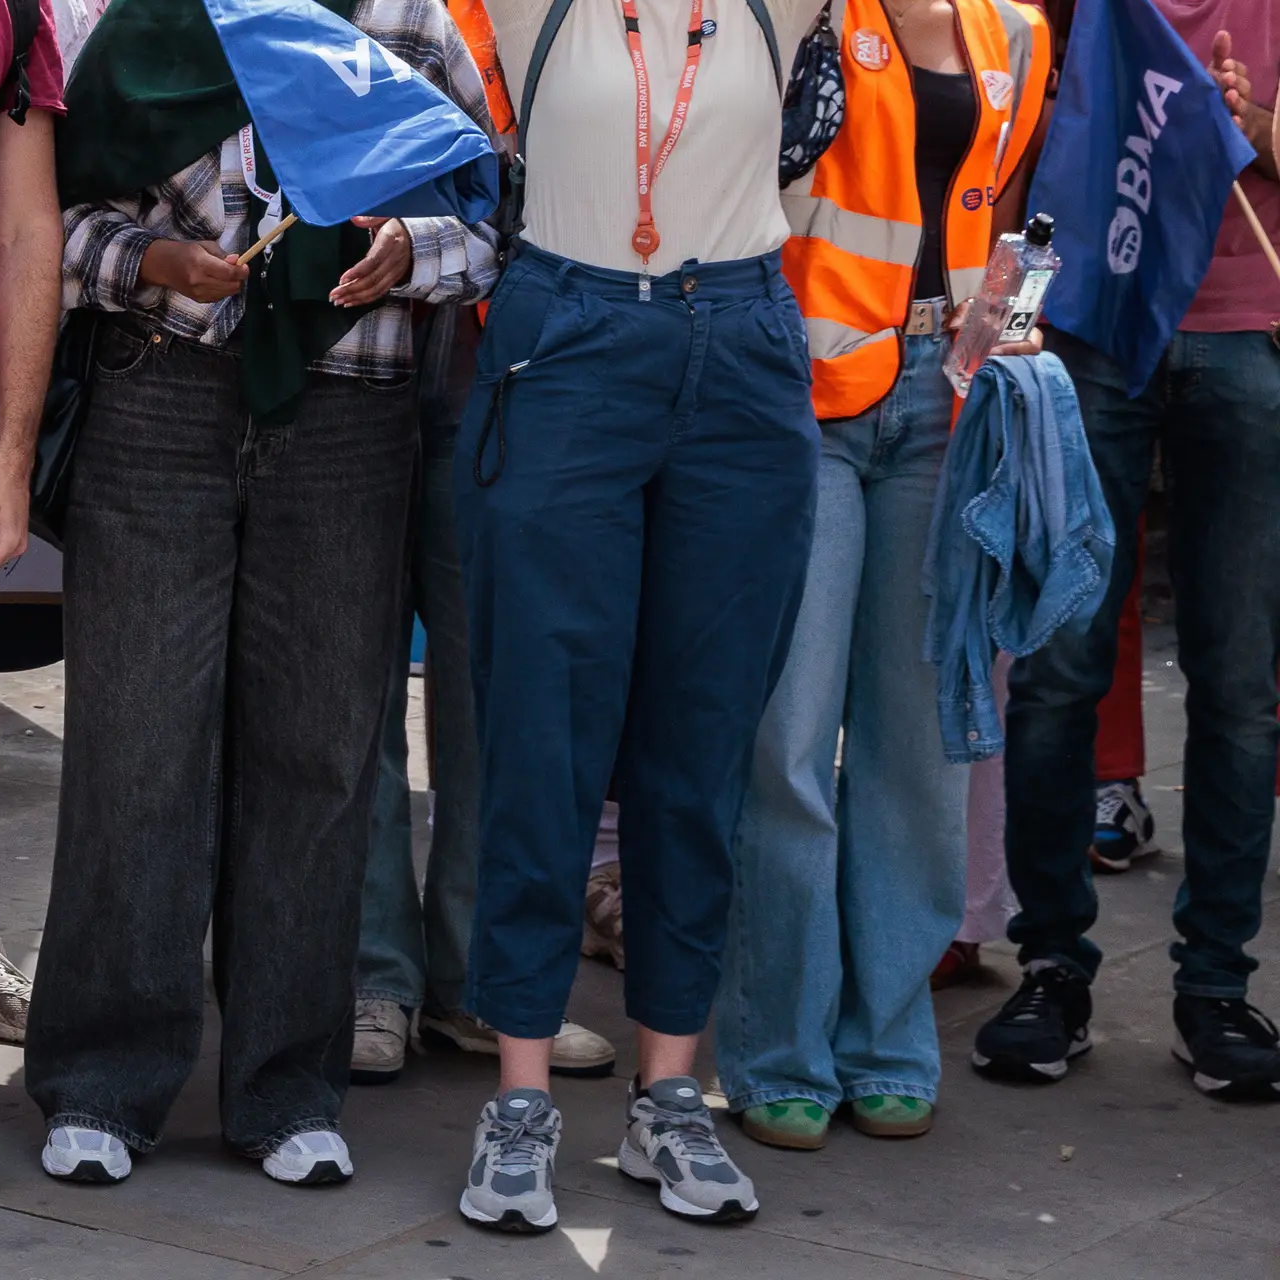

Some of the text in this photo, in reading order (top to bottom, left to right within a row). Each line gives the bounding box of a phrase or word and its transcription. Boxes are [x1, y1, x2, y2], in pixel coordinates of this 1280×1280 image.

[857, 31, 870, 63] PAY
[632, 50, 648, 147] PAY RESTORATION NOW
[677, 102, 687, 116] PAY
[1116, 68, 1184, 215] BMA
[639, 164, 648, 186] BMA
